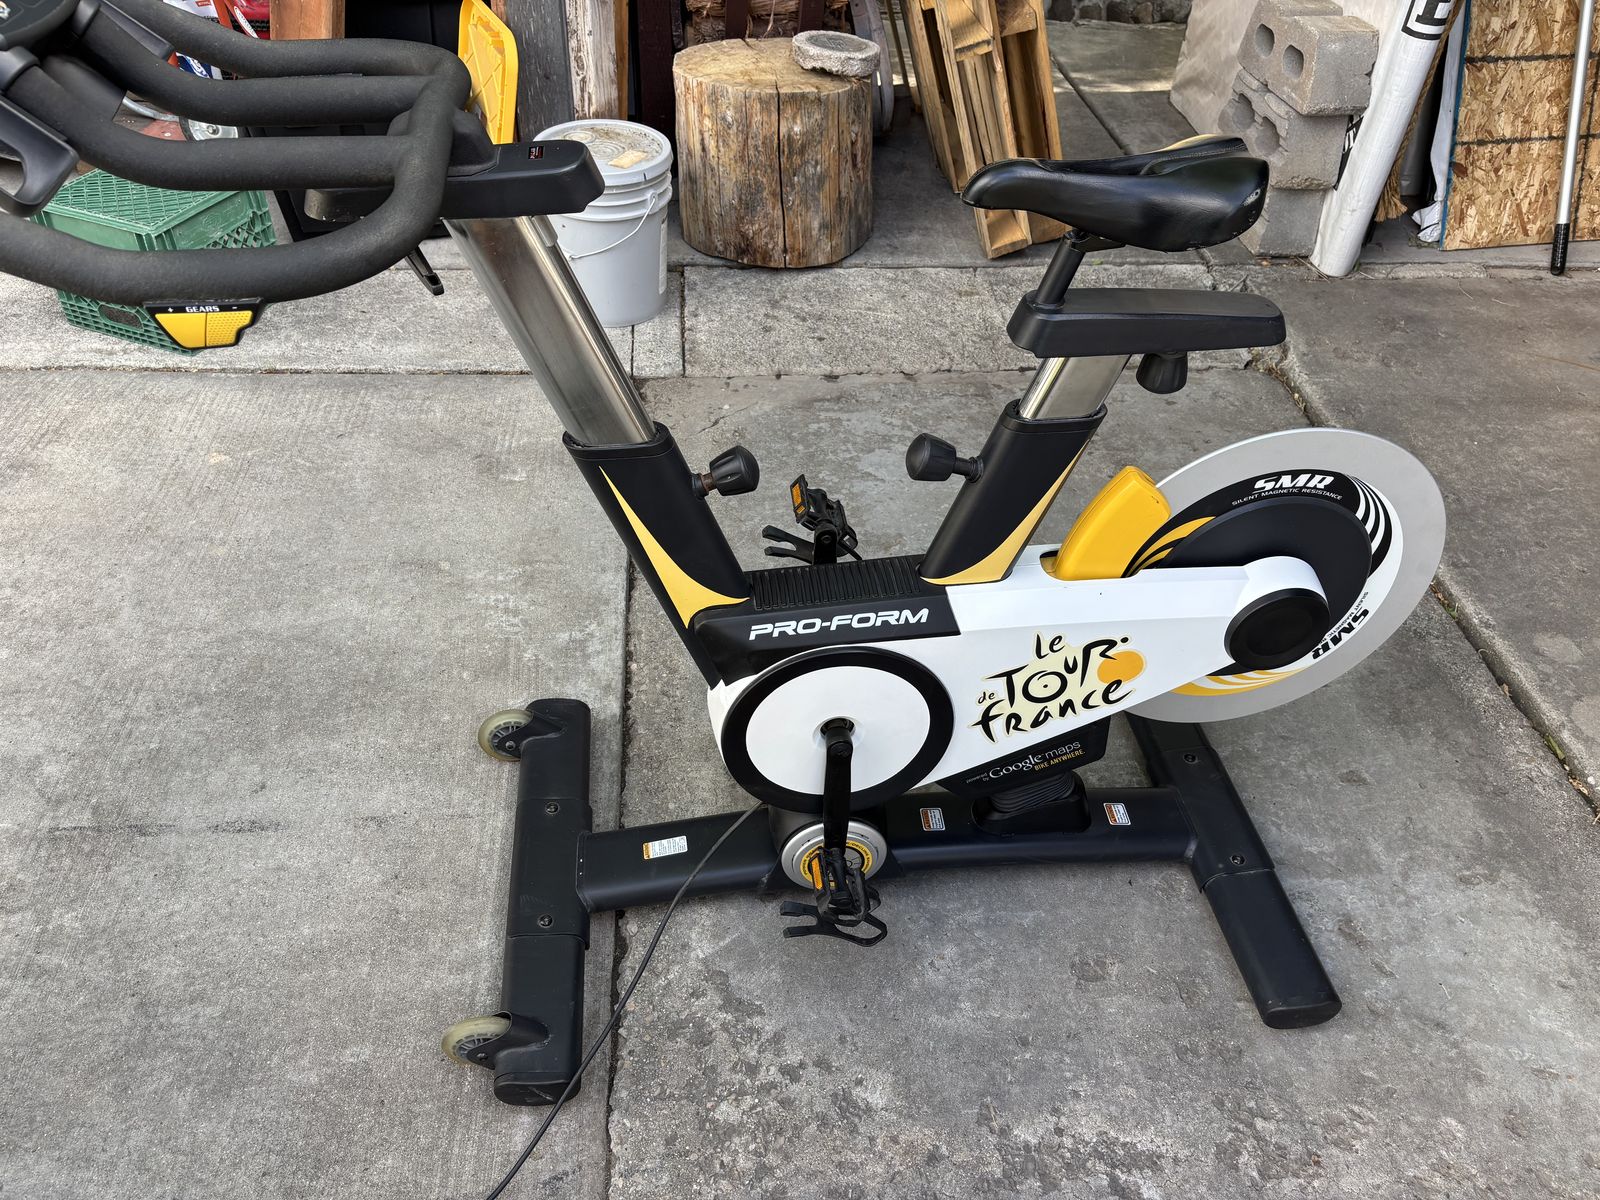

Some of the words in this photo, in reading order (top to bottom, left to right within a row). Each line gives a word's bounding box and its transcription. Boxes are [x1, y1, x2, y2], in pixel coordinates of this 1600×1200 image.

[185, 305, 220, 313] GEARS
[1252, 473, 1335, 494] SMR
[1231, 493, 1259, 506] SILENT
[1261, 487, 1300, 497] MAGNETIC
[1301, 487, 1343, 501] RESISTANCE
[749, 608, 929, 641] PRO-FORM
[1312, 608, 1370, 660] SMR
[978, 691, 996, 704] de
[989, 754, 1043, 779] Google
[1045, 741, 1081, 758] maps
[1034, 761, 1049, 771] BIKE
[1050, 749, 1086, 765] ANYWHERE.
